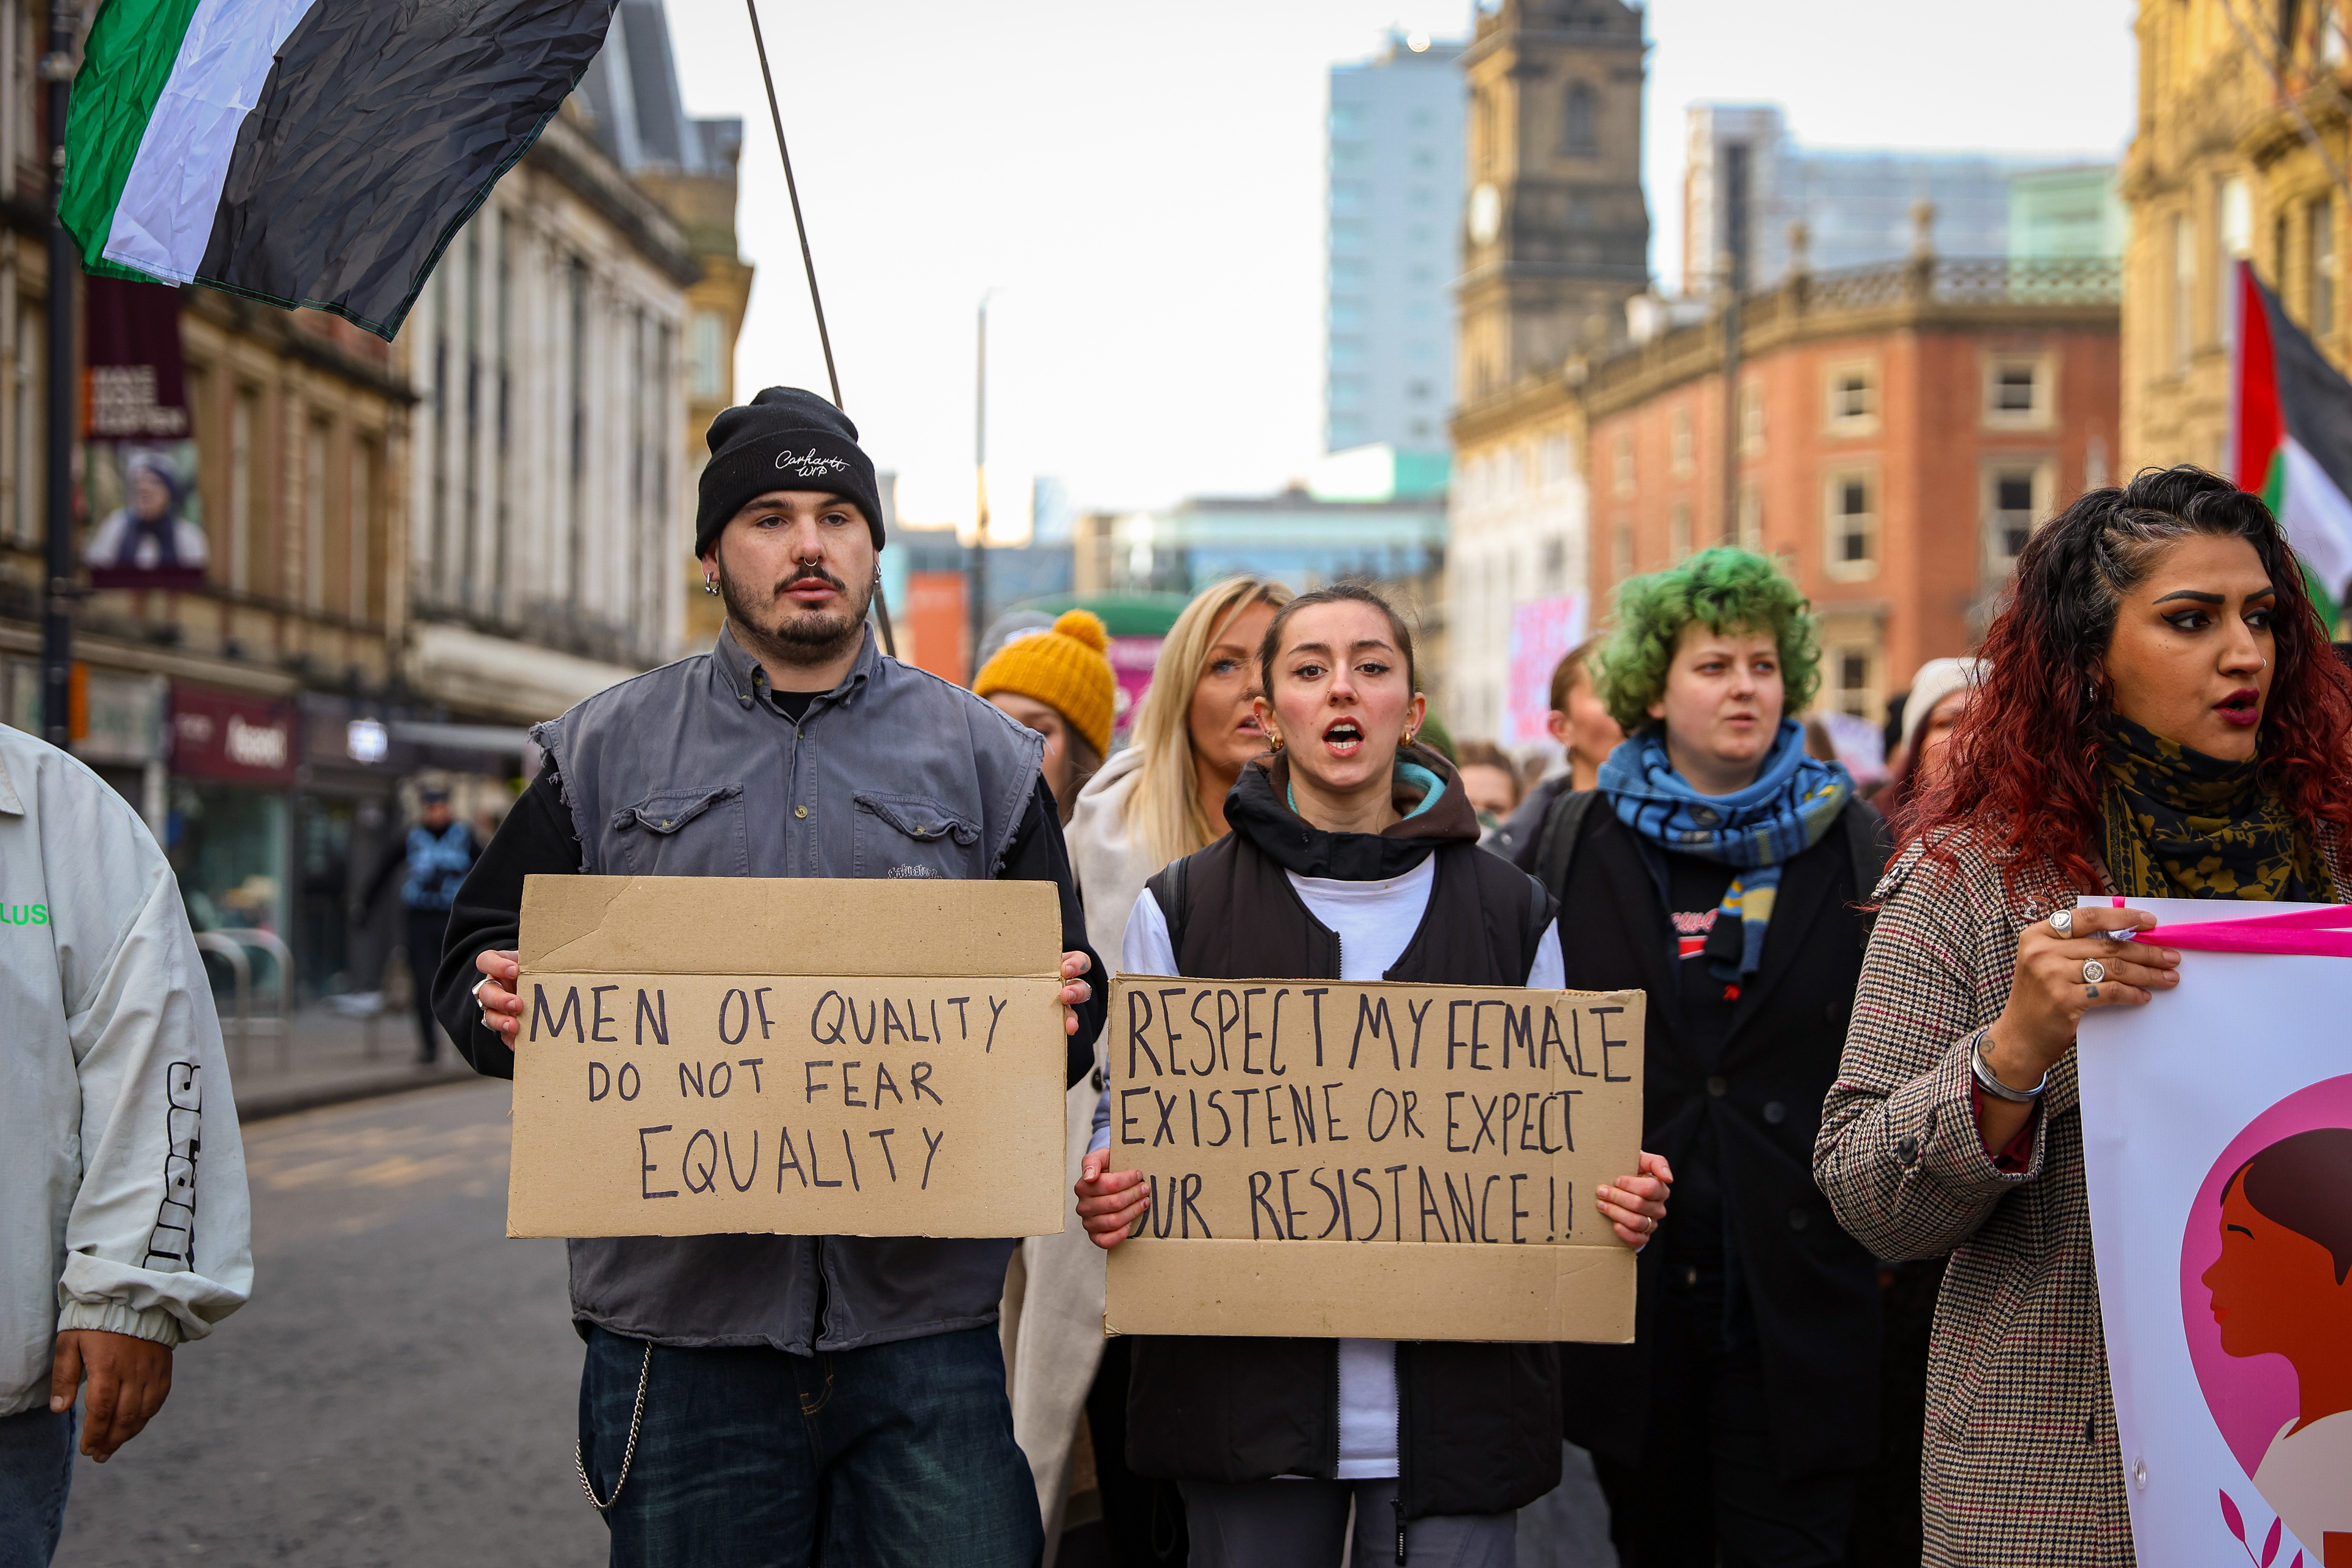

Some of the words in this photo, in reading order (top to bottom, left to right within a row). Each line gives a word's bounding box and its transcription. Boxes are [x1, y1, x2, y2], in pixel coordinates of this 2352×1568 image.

[775, 448, 851, 472] Carhartt
[794, 466, 827, 478] WIP
[0, 902, 51, 926] LUS
[529, 983, 669, 1046] MEN
[718, 987, 775, 1045] OF
[811, 990, 1008, 1054] QUALITY
[1128, 987, 1329, 1079] RESPECT
[1348, 993, 1433, 1071] MY
[1447, 1000, 1632, 1083] FEMALE
[589, 1061, 641, 1102] DO
[679, 1058, 764, 1098] NOT
[804, 1060, 943, 1110] FEAR
[1120, 1082, 1349, 1148] EXISTENE
[1368, 1087, 1425, 1142] OR
[1445, 1090, 1583, 1156] EXPECT
[639, 1125, 944, 1200] EQUALITY
[1248, 1164, 1573, 1244] RESISTANCE!!
